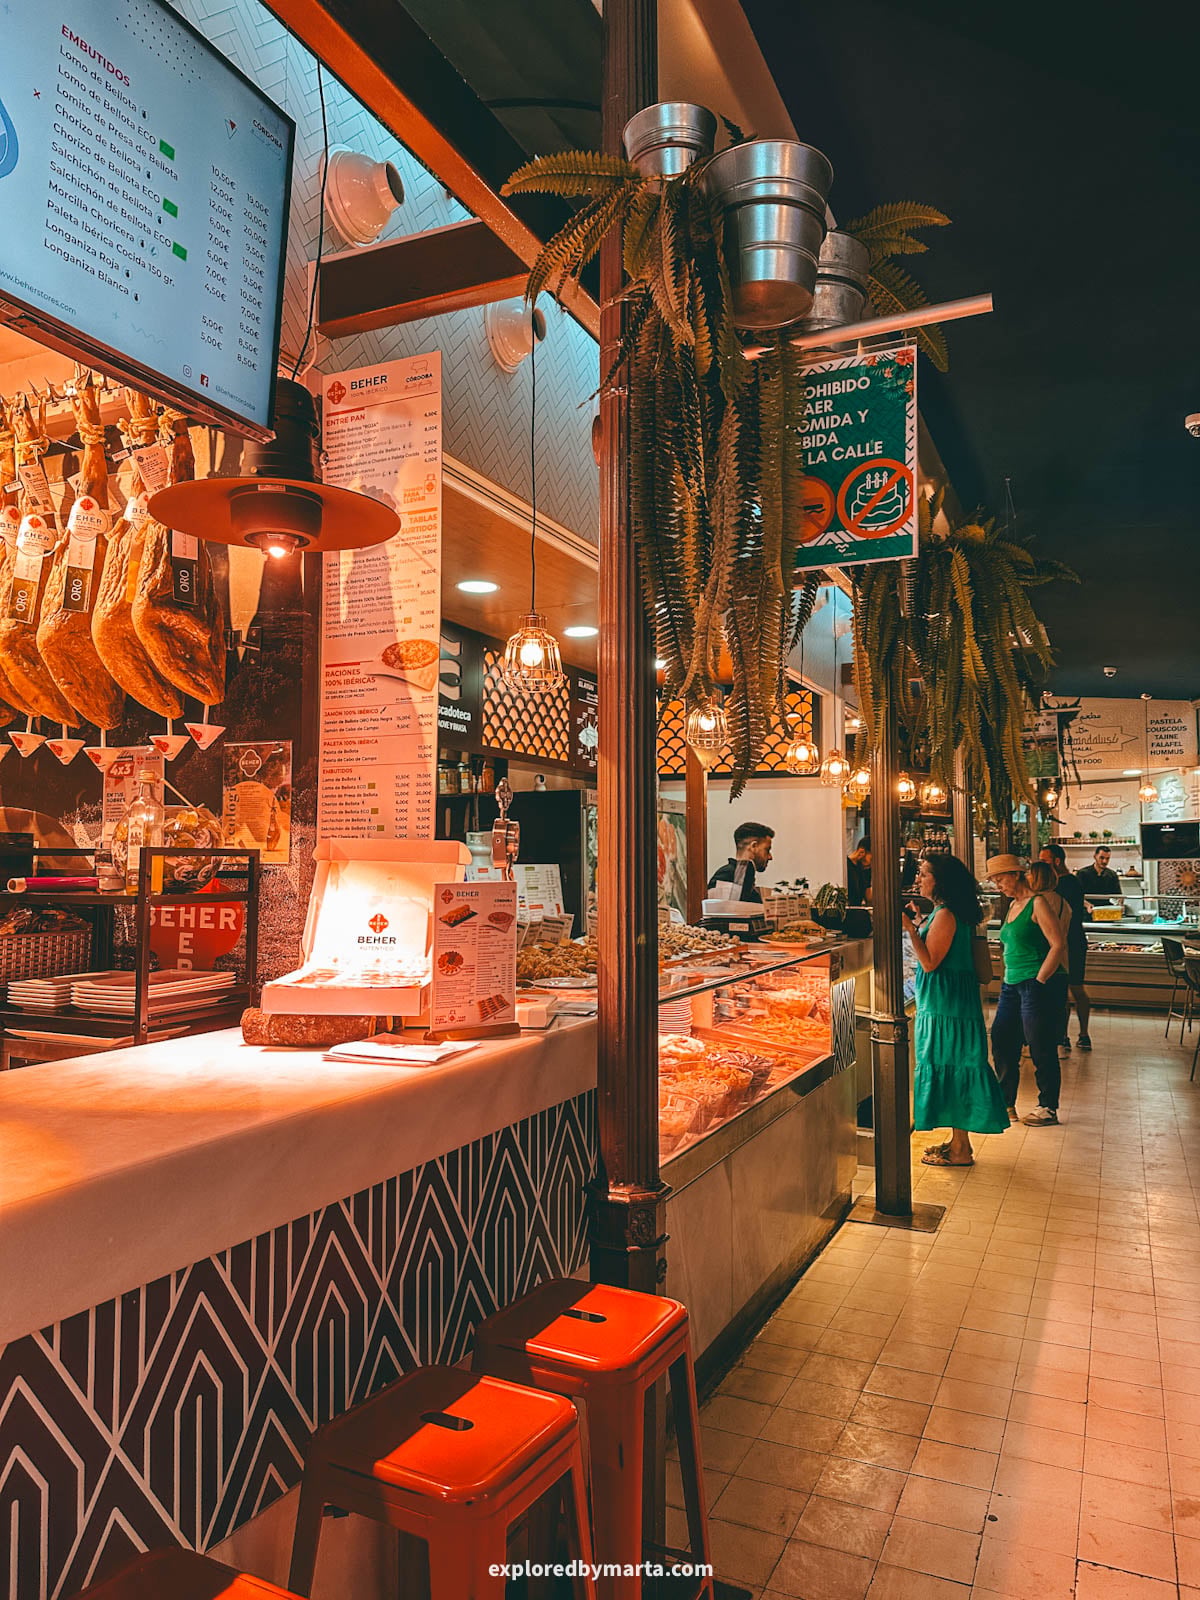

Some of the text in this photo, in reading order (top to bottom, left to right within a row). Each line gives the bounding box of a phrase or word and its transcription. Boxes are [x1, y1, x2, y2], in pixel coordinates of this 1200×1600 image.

[61, 24, 130, 87] EMBUTIDOS
[60, 44, 137, 112] Lomo de Bellota
[58, 64, 157, 145] Lomo de Bellota ECO
[55, 103, 141, 172] Chorizo de Bellota
[56, 83, 178, 181] Lomito de Presa de Bellota
[53, 122, 161, 204] Chorizo de Bellota ECO
[51, 141, 153, 217] Salchichón de Bellota
[49, 160, 172, 248] Salchichón de Bellota ECO
[210, 181, 234, 206] 12,00€
[48, 180, 135, 242] Morcilla Choricera
[209, 198, 233, 222] 12,00€
[243, 208, 268, 232] 20,00€
[209, 216, 231, 237] 6,00€
[243, 224, 268, 248] 20,00€
[45, 218, 120, 271] Longaniza Roja
[47, 199, 175, 287] Paleta Ibérica Cocida 150 gr.
[208, 232, 230, 253] 7,00€
[44, 238, 129, 295] Longaniza Blanca
[207, 249, 229, 270] 6,00€
[242, 256, 265, 278] 10,50€
[205, 265, 227, 286] 7,00€
[0, 269, 77, 316] ww.beherstores.com
[204, 283, 226, 302] 4,50€
[239, 288, 263, 309] 10,50€
[202, 315, 223, 335] 5,00€
[240, 306, 261, 325] 7,00€
[200, 331, 222, 350] 5,00€
[350, 375, 388, 390] BEHER
[803, 376, 871, 399] OHIBIDO
[803, 399, 834, 416] AER
[326, 413, 366, 427] ENTRE PAN
[797, 408, 870, 433] OMIDA Y
[802, 431, 839, 449] BIDA
[807, 440, 883, 465] LA CALLE
[75, 514, 102, 525] EHER
[401, 524, 438, 535] SURTIDOS
[409, 514, 438, 524] TABLAS
[70, 578, 83, 601] ORO
[179, 569, 190, 593] ORO
[15, 590, 29, 613] ORO
[325, 669, 360, 678] RACIONES
[325, 677, 376, 687] 100% IBÉRICAS
[109, 763, 131, 776] 4x3
[357, 935, 397, 945] BEHER
